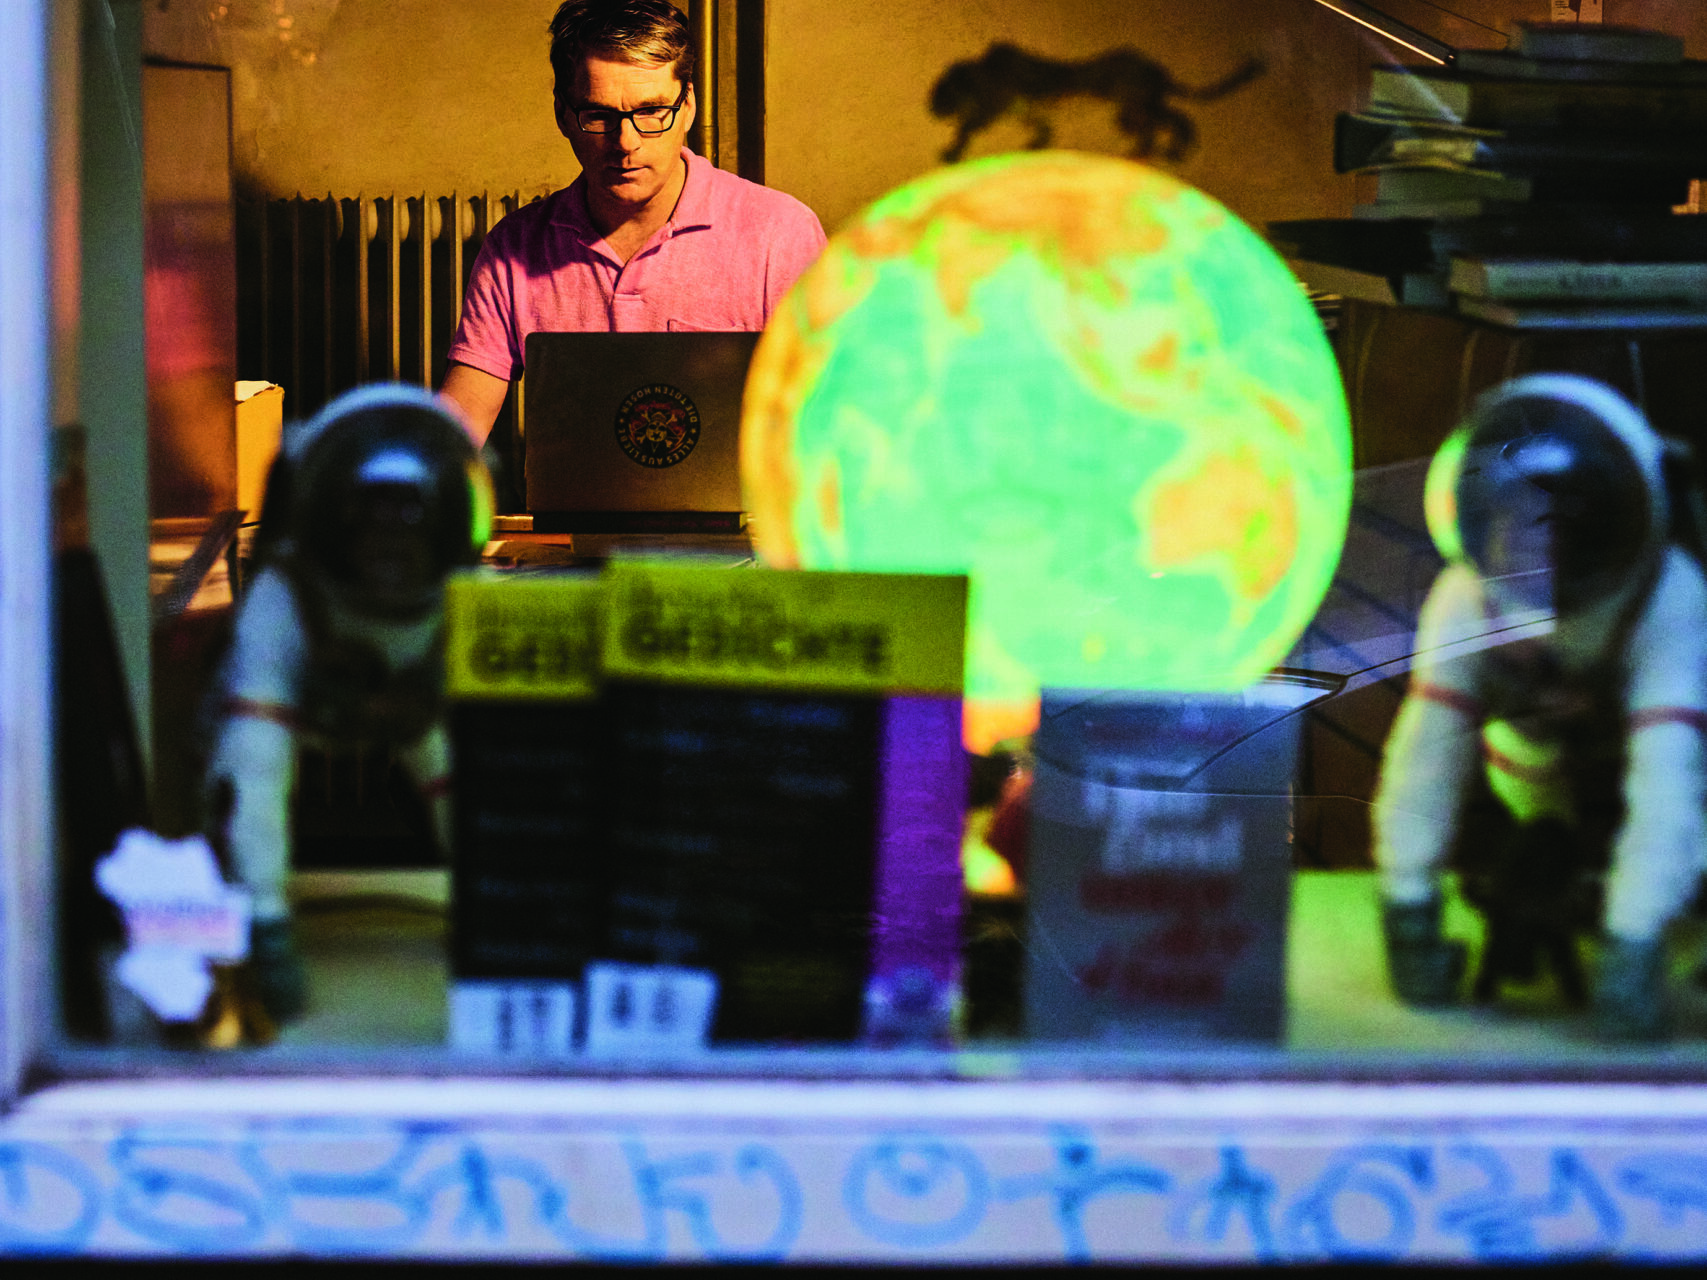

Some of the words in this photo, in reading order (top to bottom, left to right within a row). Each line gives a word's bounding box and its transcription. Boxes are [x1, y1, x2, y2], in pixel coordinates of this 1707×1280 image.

[622, 388, 651, 413] HOSEN
[655, 387, 687, 405] TOTEN
[685, 405, 698, 423] DIE
[618, 428, 640, 458] LIEBE
[666, 438, 694, 464] ALLES
[641, 454, 663, 465] AUS
